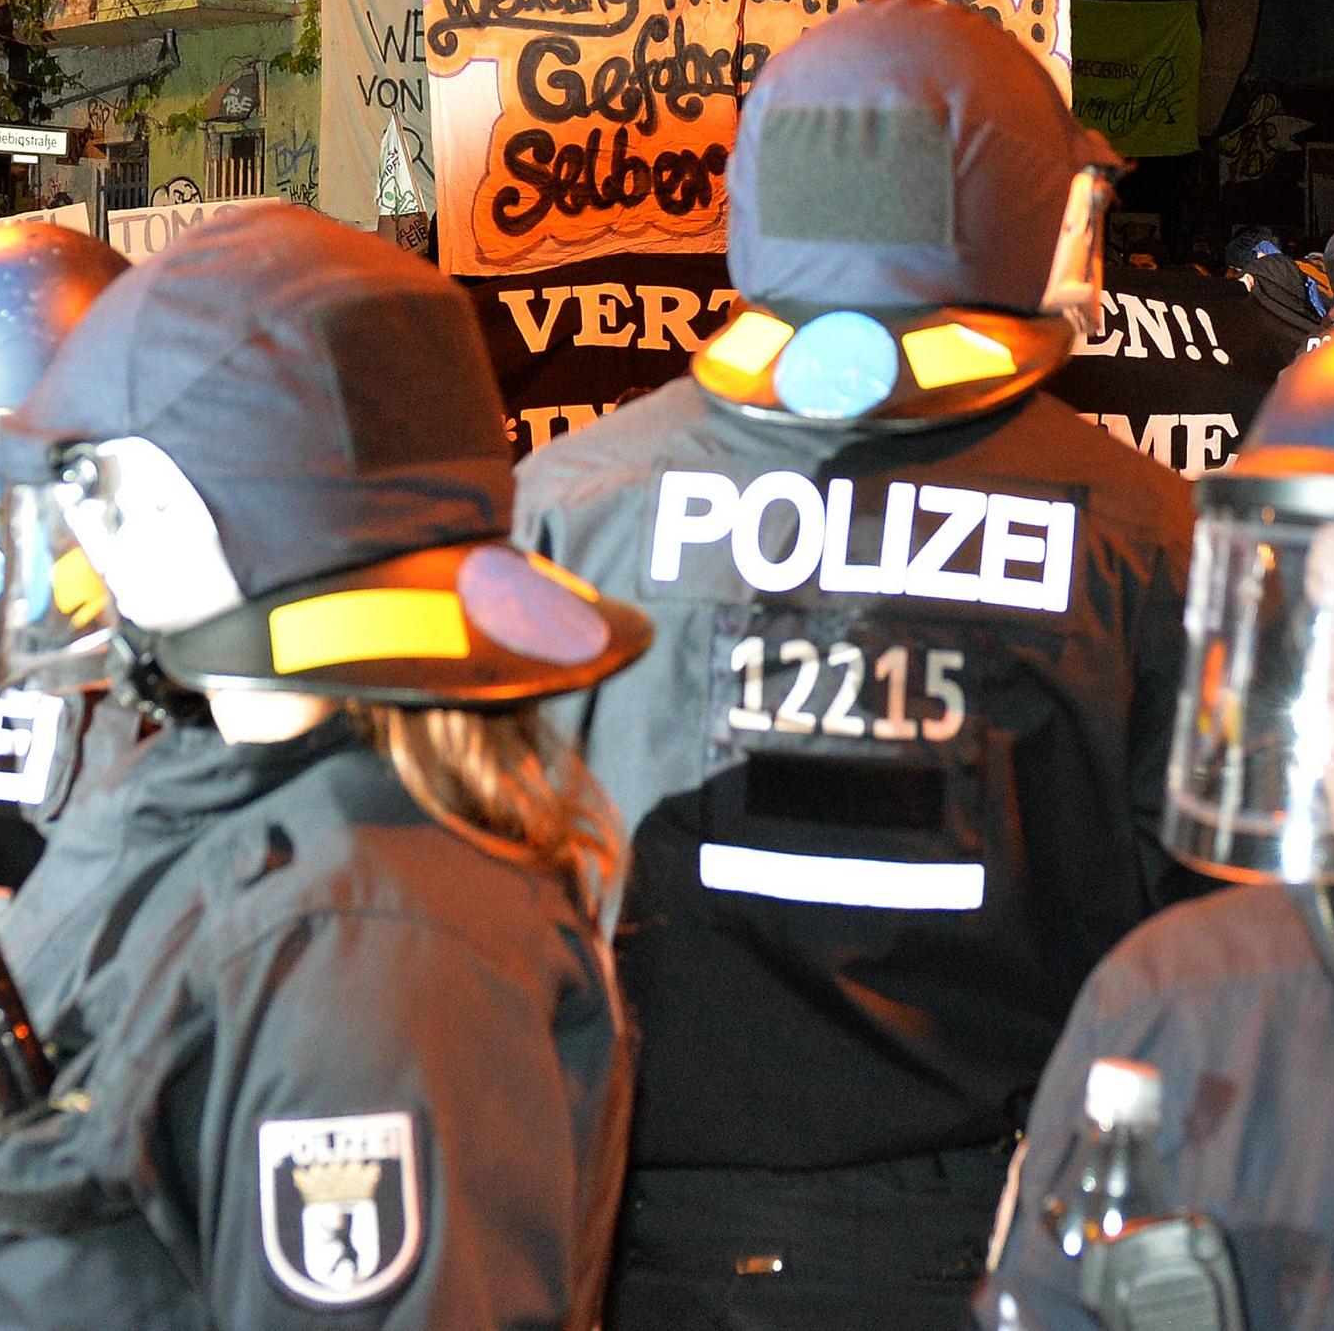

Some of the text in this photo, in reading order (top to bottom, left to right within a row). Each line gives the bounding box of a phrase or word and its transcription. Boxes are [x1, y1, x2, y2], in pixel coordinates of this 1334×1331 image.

[357, 74, 424, 113] VON
[650, 470, 1075, 613] POLIZEI
[729, 636, 966, 742] 12215
